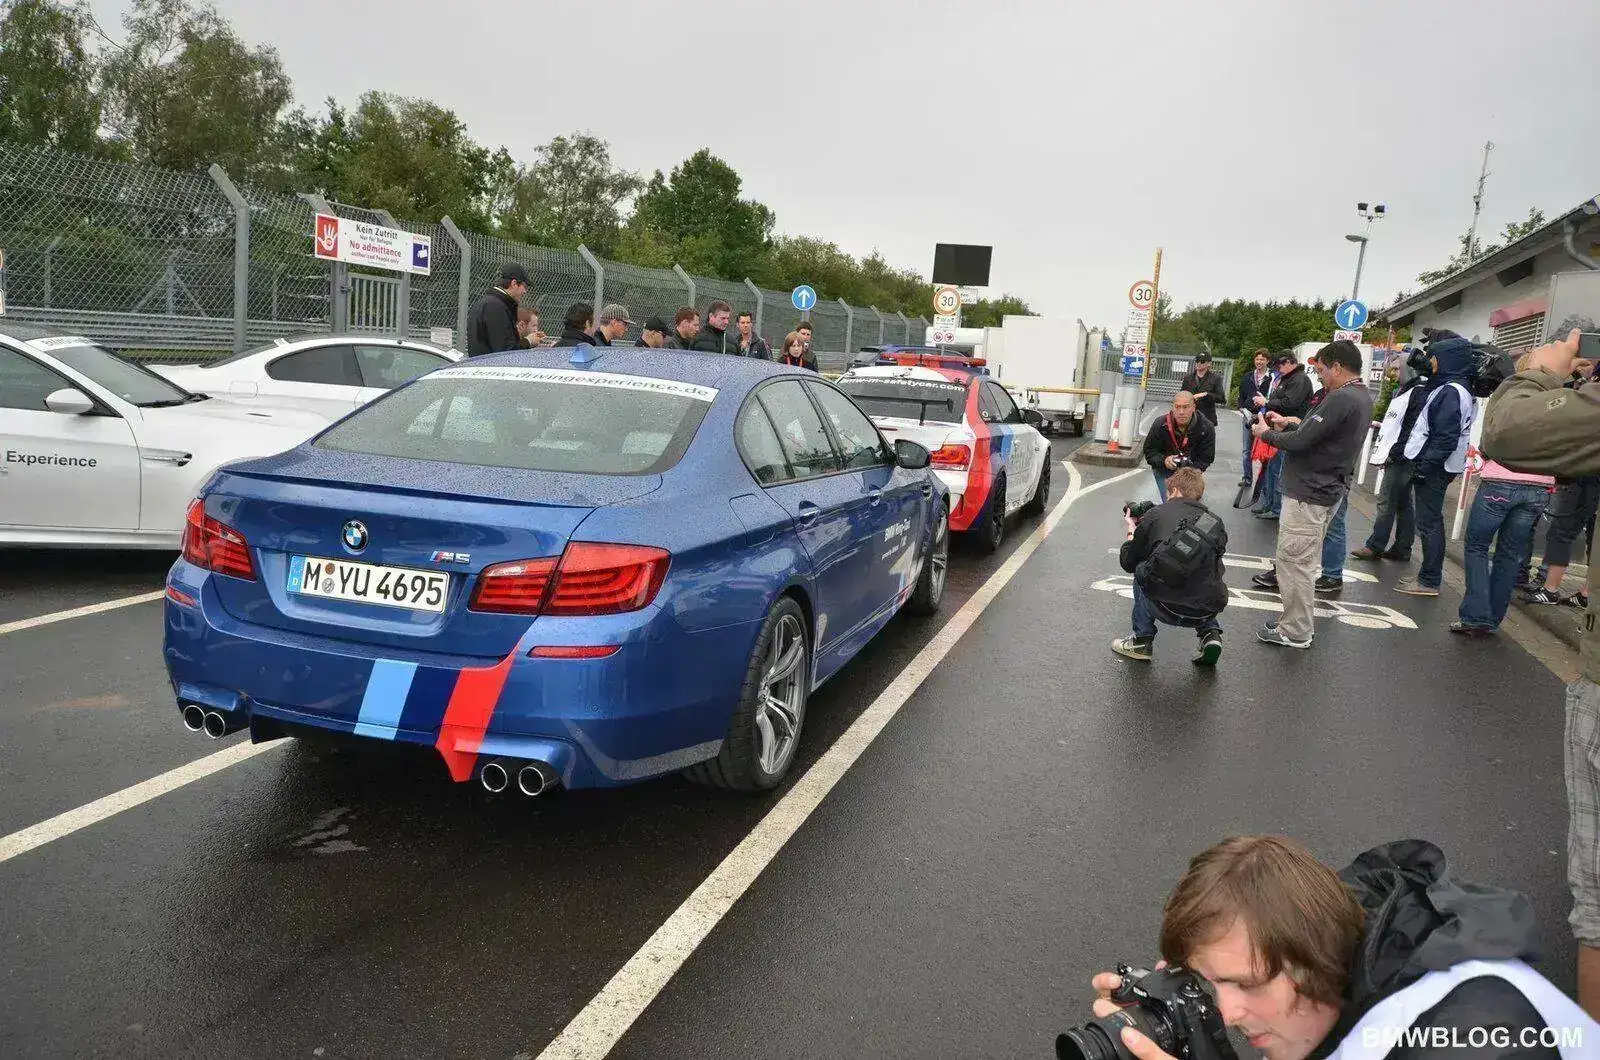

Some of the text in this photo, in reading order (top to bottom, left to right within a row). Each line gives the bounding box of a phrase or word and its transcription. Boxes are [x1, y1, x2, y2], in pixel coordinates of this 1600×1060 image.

[356, 224, 398, 240] Kein Zutritt
[350, 240, 402, 258] No admittance
[941, 296, 954, 307] 30
[1135, 288, 1152, 301] 30
[6, 450, 97, 468] Experience
[302, 561, 444, 606] M YU 4695
